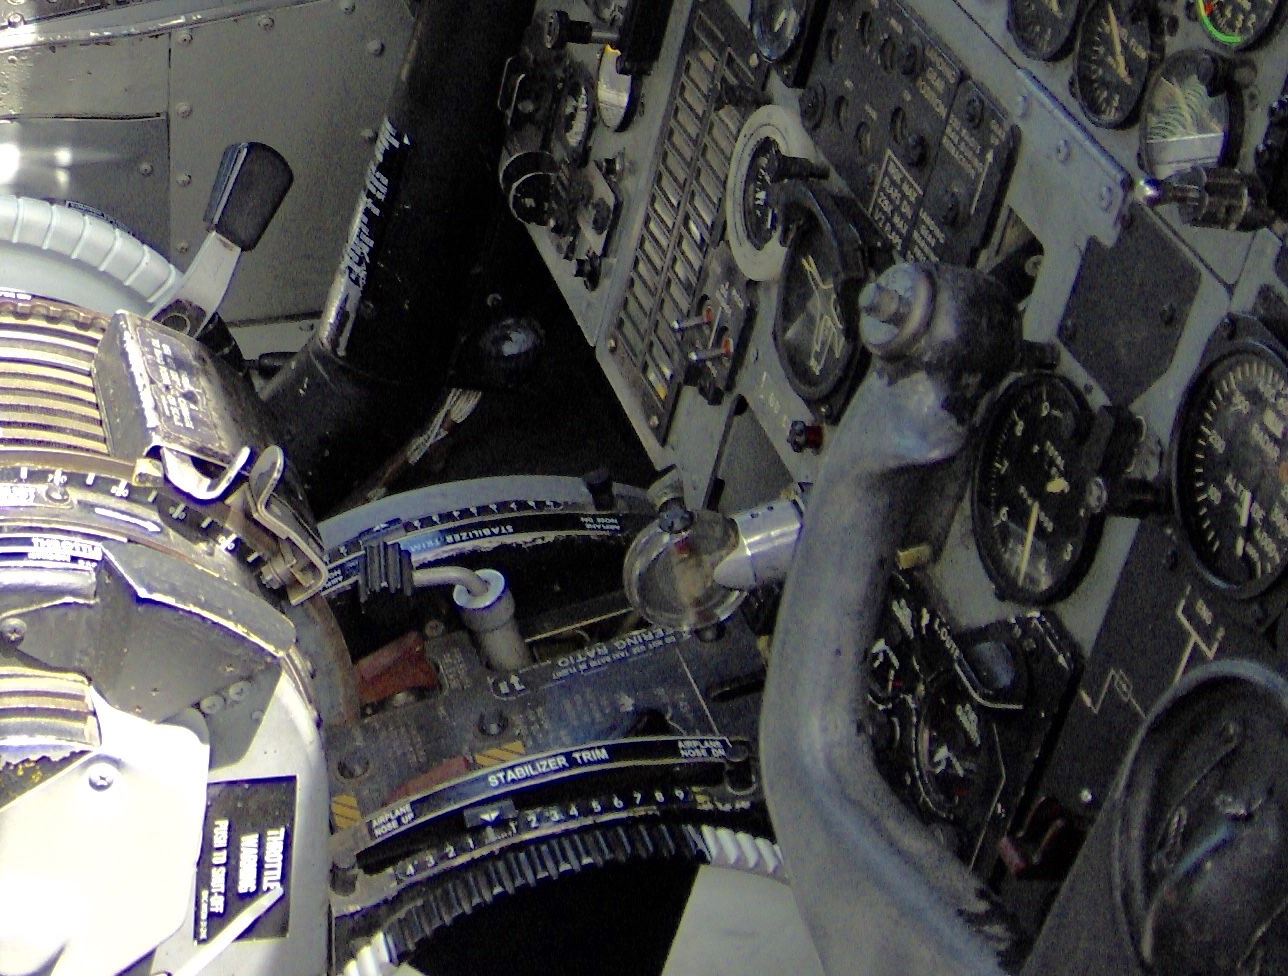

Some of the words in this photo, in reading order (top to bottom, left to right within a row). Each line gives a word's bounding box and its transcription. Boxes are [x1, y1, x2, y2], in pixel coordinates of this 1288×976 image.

[408, 534, 442, 553] TRIM
[445, 524, 514, 545] STABILIZER
[487, 754, 570, 787] STABILIZER
[572, 747, 610, 765] TRIM
[569, 803, 579, 817] 4
[591, 799, 602, 813] 5
[612, 793, 624, 809] 6
[633, 790, 642, 805] 7
[654, 789, 665, 803] 8
[674, 788, 685, 801] 9
[213, 819, 229, 849] PUSH
[211, 848, 228, 865] TO
[237, 833, 260, 895] WARNING
[262, 826, 285, 892] THROTTLE
[209, 865, 226, 914] SHUT-OFF
